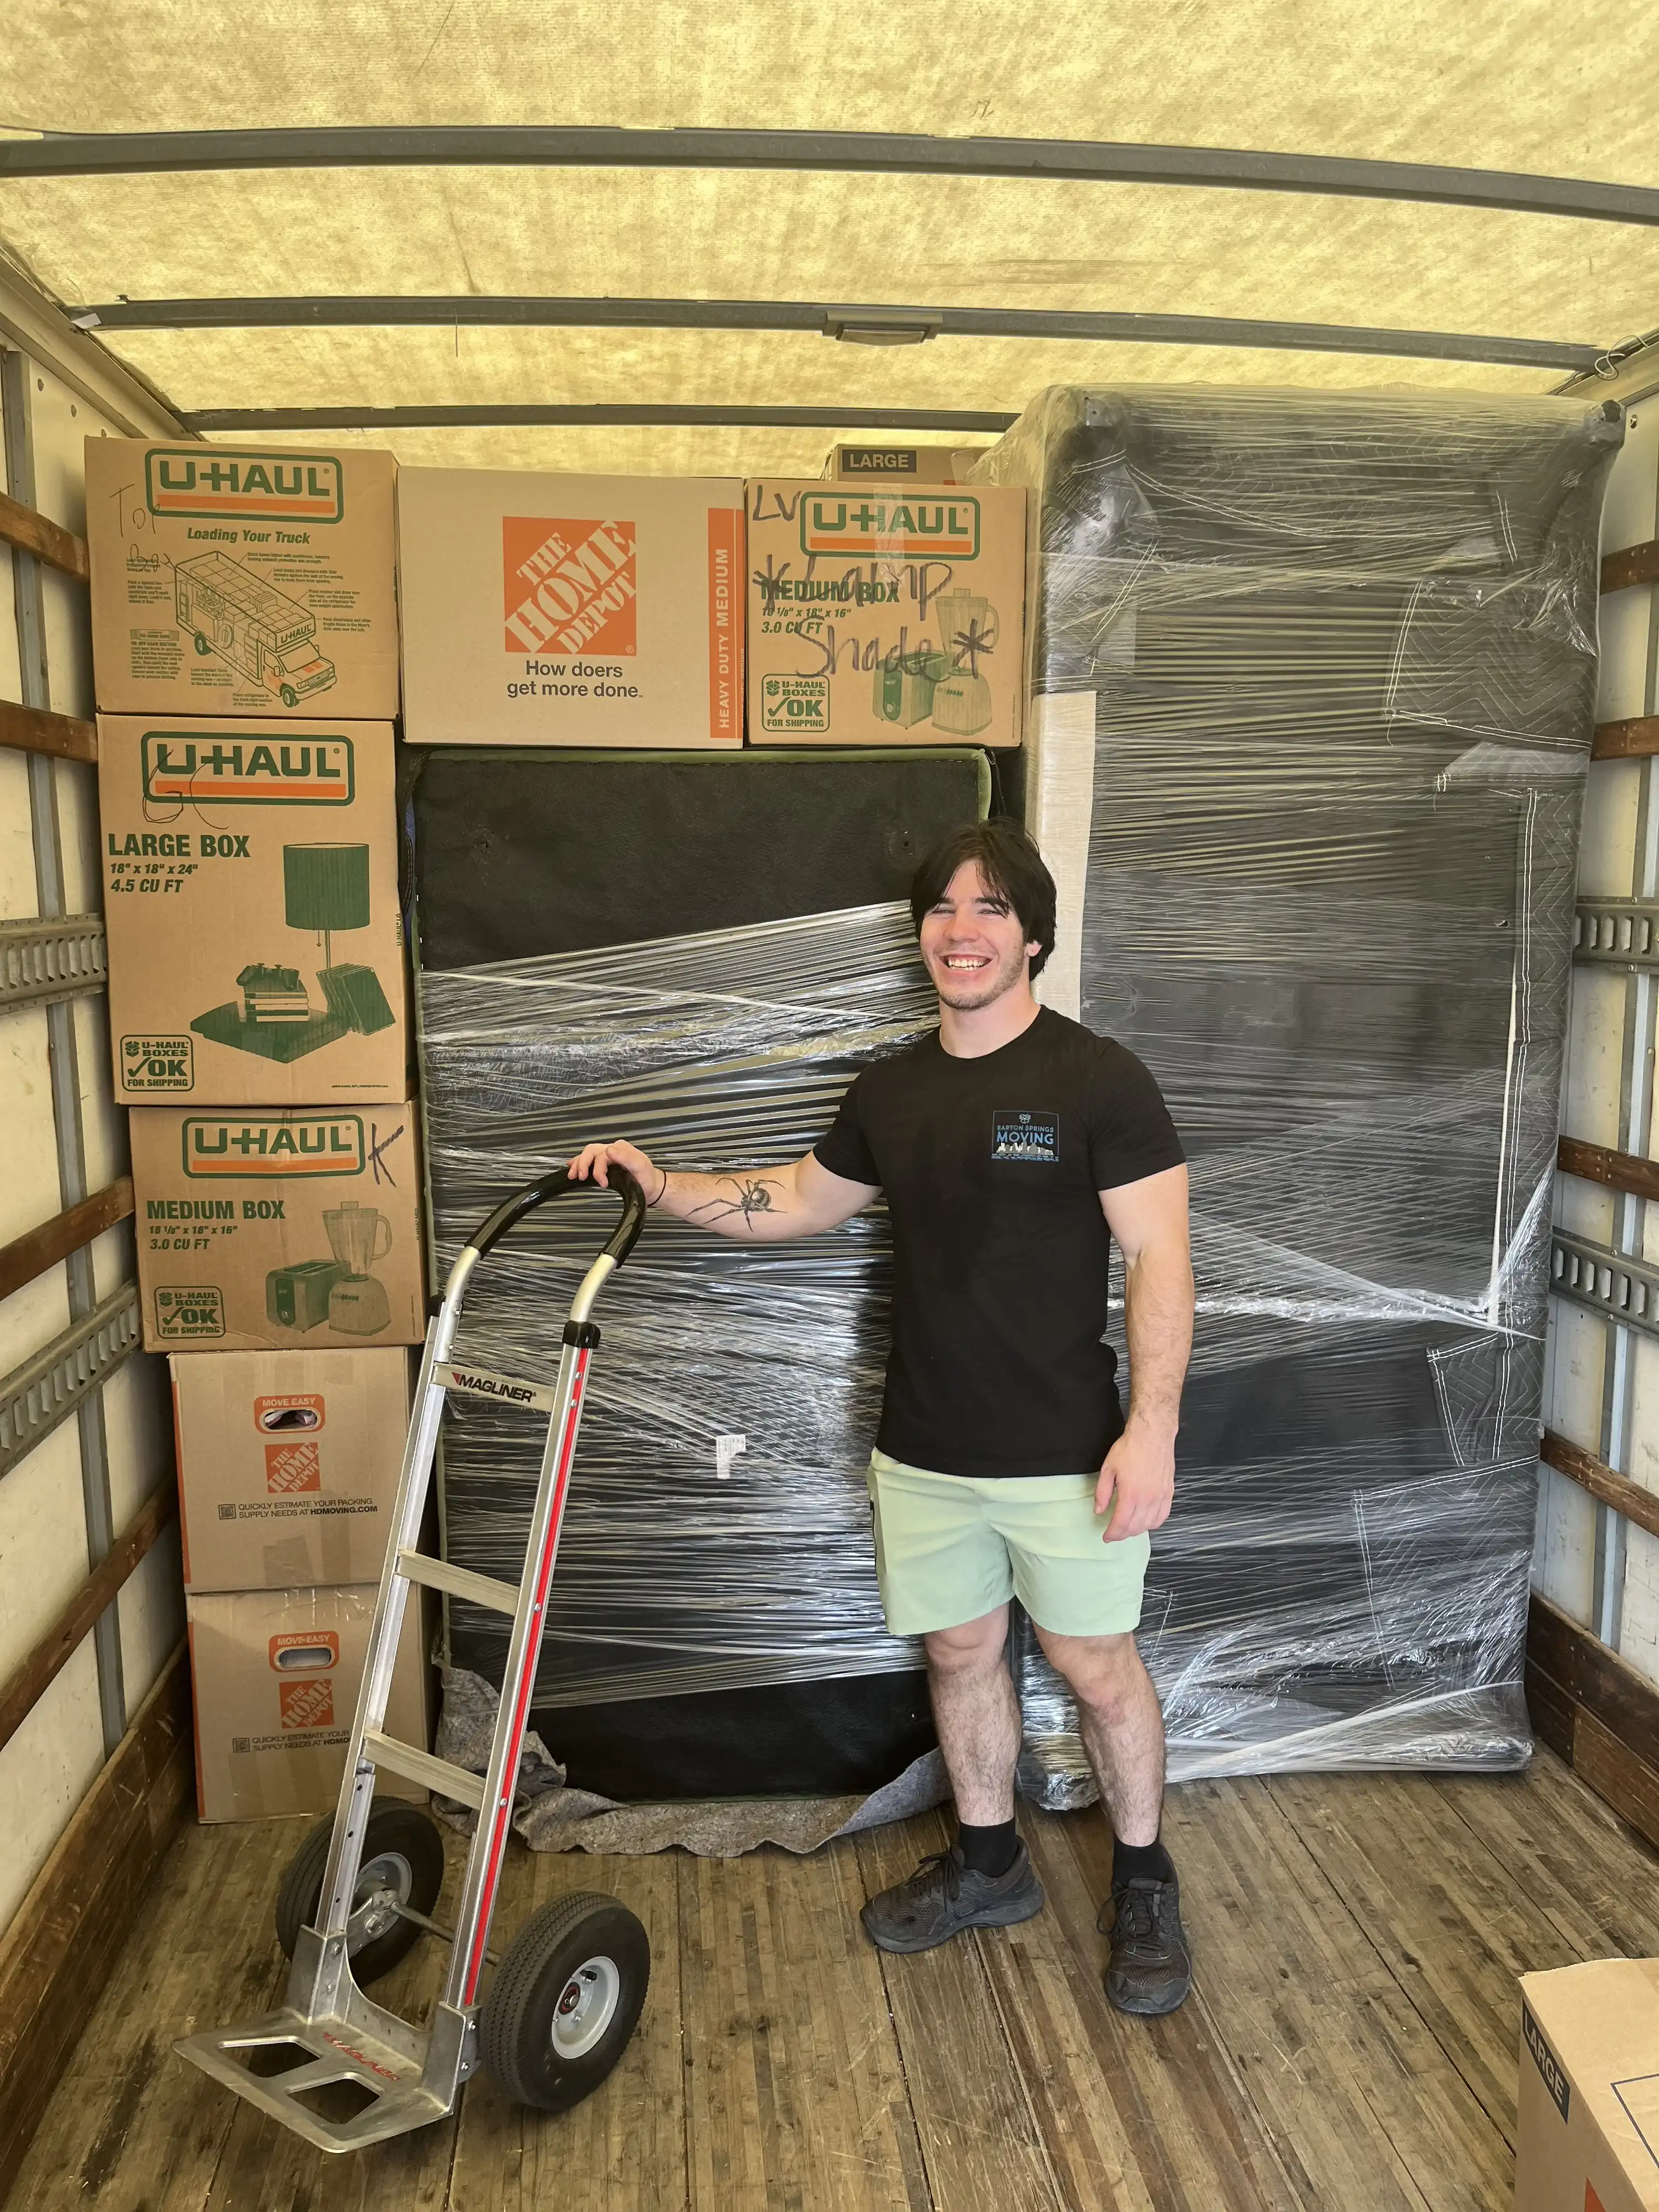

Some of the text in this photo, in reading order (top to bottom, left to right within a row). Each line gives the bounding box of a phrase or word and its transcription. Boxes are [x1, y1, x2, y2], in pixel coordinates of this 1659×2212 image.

[849, 454, 909, 468] LARGE
[159, 460, 330, 496] U-HAUL
[813, 503, 968, 534] U-HAUL
[187, 527, 311, 545] Loading Your Truck
[516, 532, 572, 586] THE
[504, 521, 636, 653] HOME
[761, 580, 900, 603] MEDIUM BOX
[556, 571, 636, 654] DEPOT
[835, 608, 851, 618] 16"
[761, 621, 823, 634] 3.0 CU FT
[716, 549, 730, 728] HEAVY DUTY MEDIUM
[526, 660, 623, 678] How doers
[507, 681, 537, 698] get
[542, 684, 588, 696] more
[787, 699, 824, 717] OK
[157, 743, 341, 777] U-HAUL
[108, 833, 251, 857] LARGE BOX
[110, 863, 198, 874] 18" x 18" x 24"
[110, 878, 184, 893] 4.5 CU FT
[148, 1059, 188, 1076] OK
[147, 1079, 188, 1087] SHIPPING
[195, 1126, 352, 1154] U-HAUL
[996, 1131, 1054, 1145] MOVING
[368, 1122, 404, 1188] K
[147, 1200, 286, 1219] MEDIUM BOX
[150, 1238, 210, 1250] 3.0 CU FT
[181, 1308, 219, 1324] OK
[459, 1374, 533, 1403] MAGLINER
[262, 1397, 315, 1407] MOVE EASY
[268, 1442, 318, 1493] HOME
[271, 1448, 292, 1469] THE
[289, 1460, 319, 1492] DEPOT
[238, 1503, 273, 1511] QUICKLY
[311, 1505, 377, 1515] HDMOVING.COM
[277, 1634, 330, 1645] MOVE EASY
[281, 1679, 332, 1729] HOME
[285, 1685, 307, 1705] THE
[302, 1696, 332, 1727] DEPOT
[252, 1735, 286, 1743] QUICKLY
[287, 1733, 325, 1741] ESTIMATE
[253, 1743, 283, 1751] SUPPLY
[1524, 2010, 1564, 2105] LARGE
